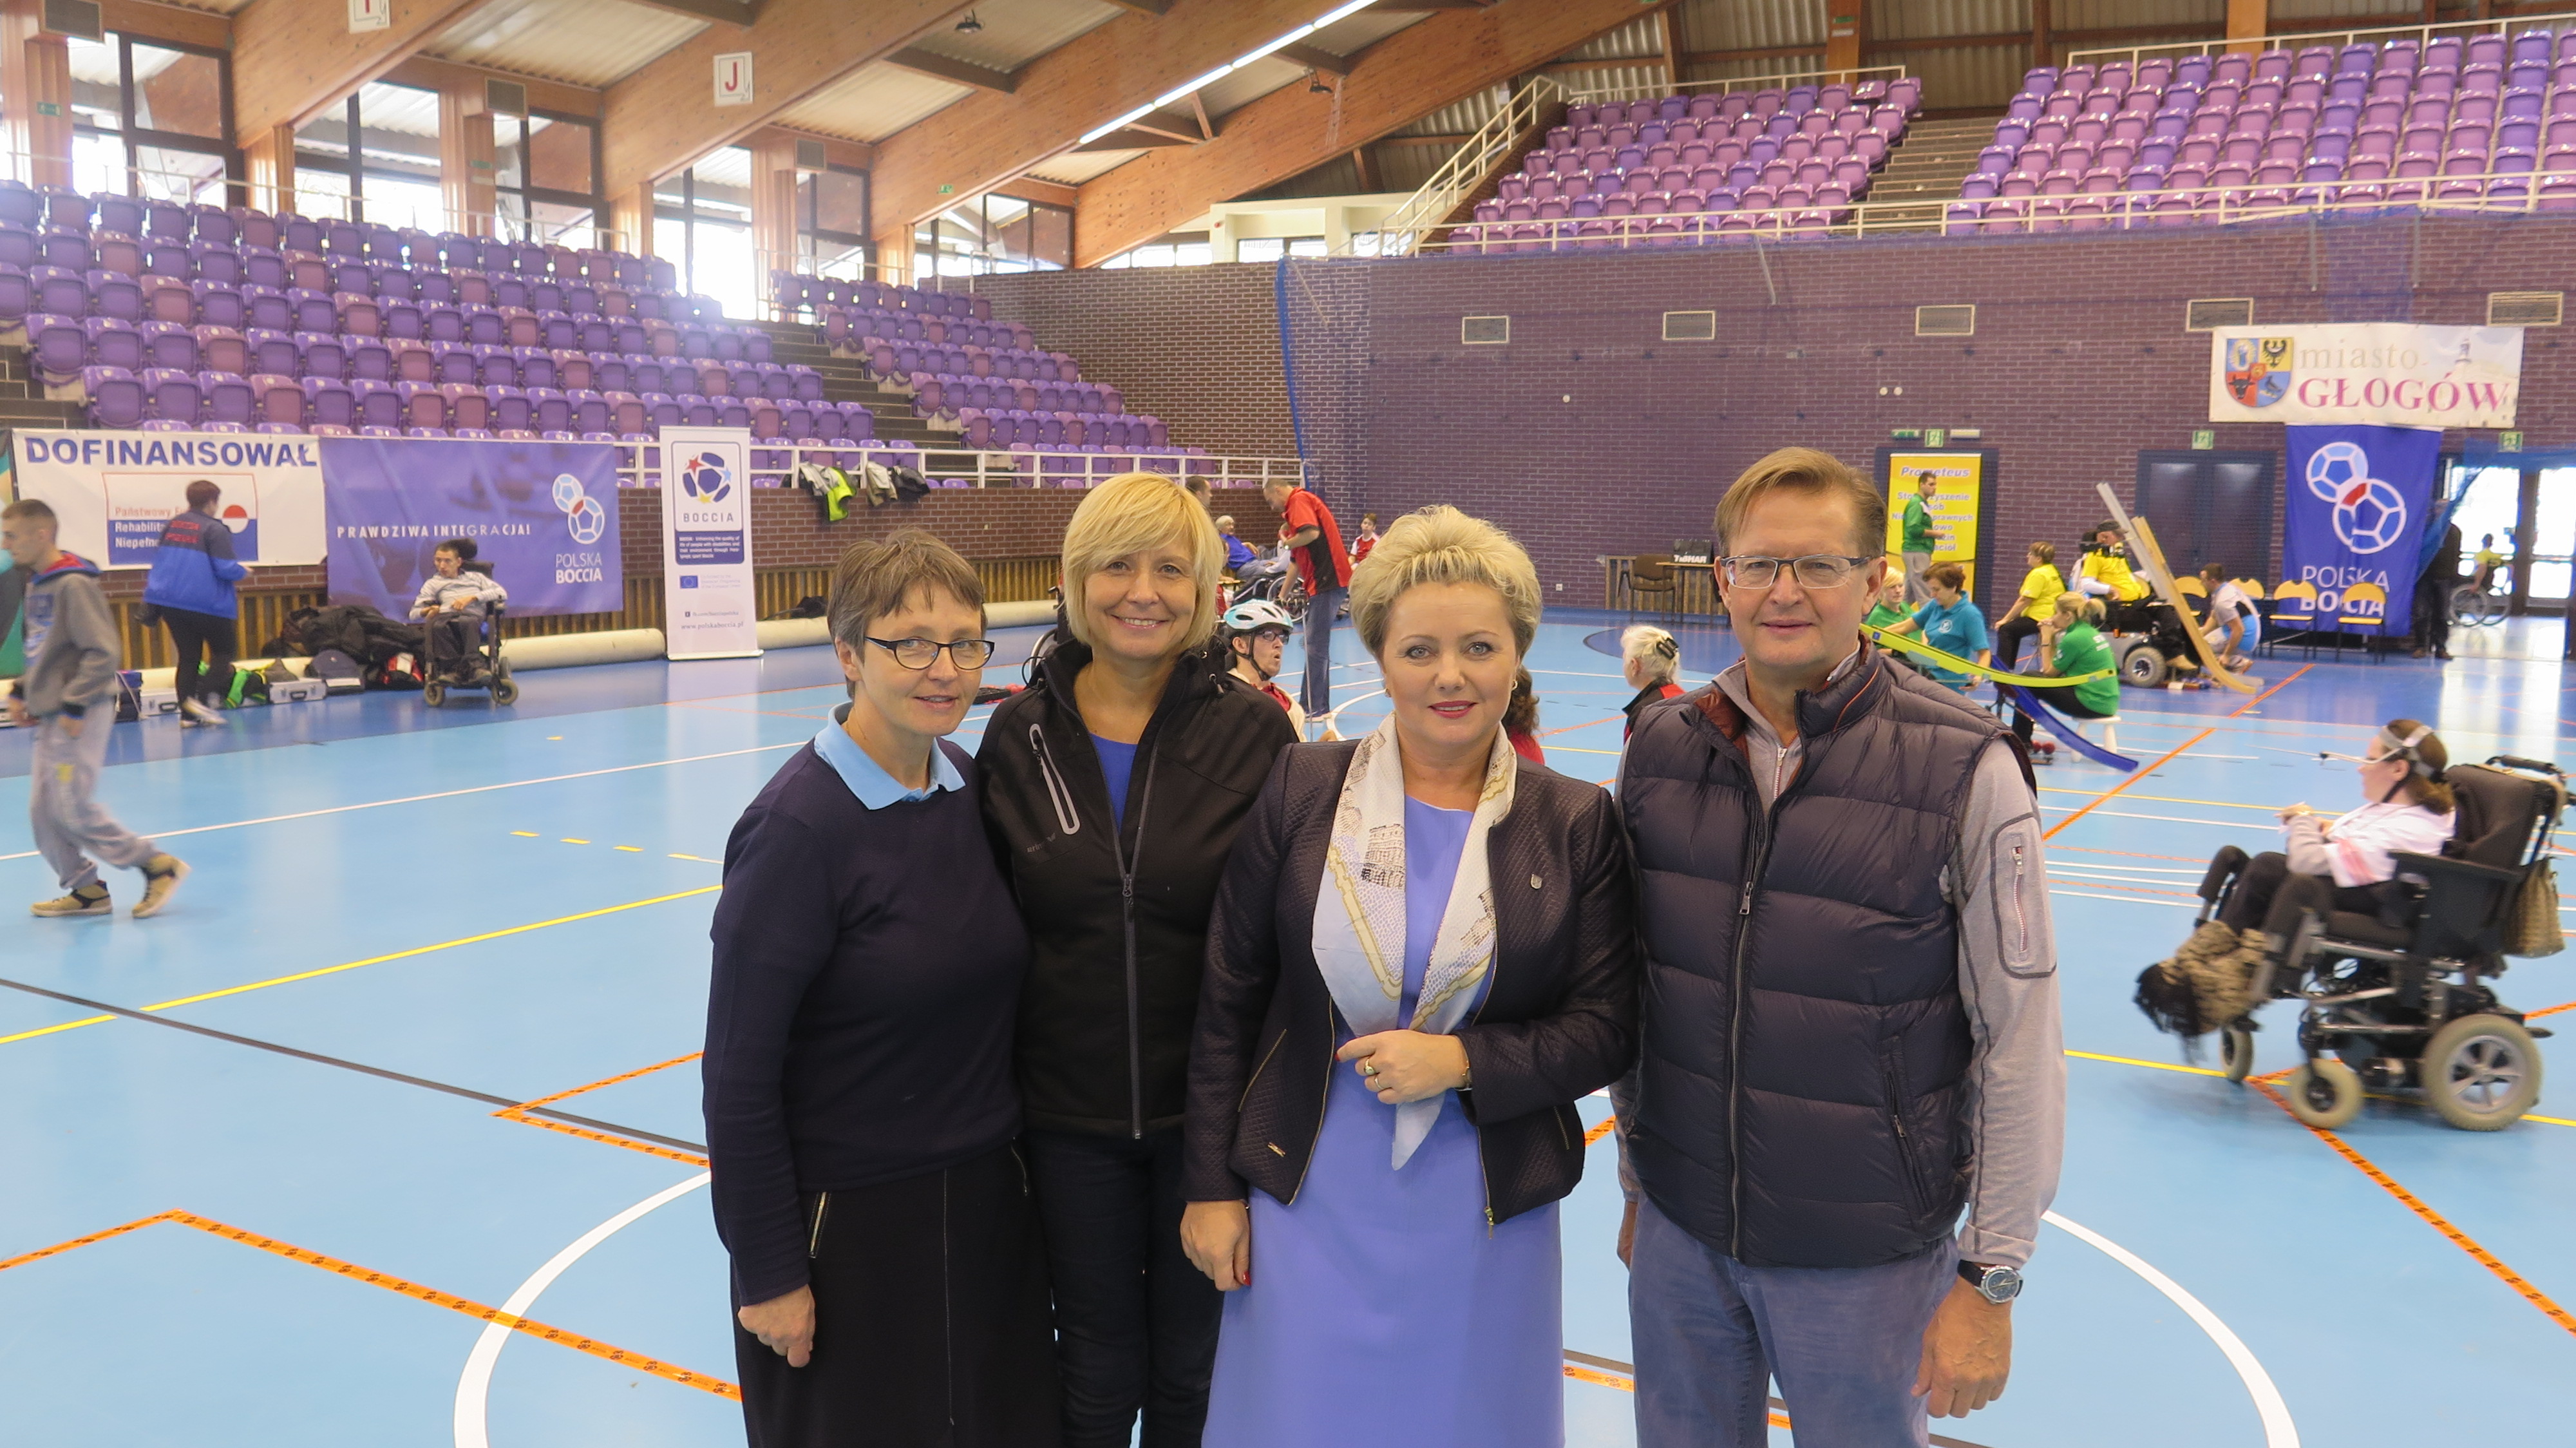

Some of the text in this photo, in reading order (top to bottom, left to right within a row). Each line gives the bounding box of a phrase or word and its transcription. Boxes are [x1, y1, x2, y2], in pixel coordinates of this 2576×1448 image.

[724, 62, 737, 91] J
[2300, 338, 2419, 369] miasto
[2298, 373, 2510, 412] GŁOGÓW
[24, 437, 317, 467] DOFINANSOWAŁ
[683, 513, 734, 522] BOCCIA
[337, 524, 531, 538] PRAWDZIWA INTEGRACJA!
[556, 552, 602, 567] POLSKA
[556, 567, 603, 584] BOCCIA
